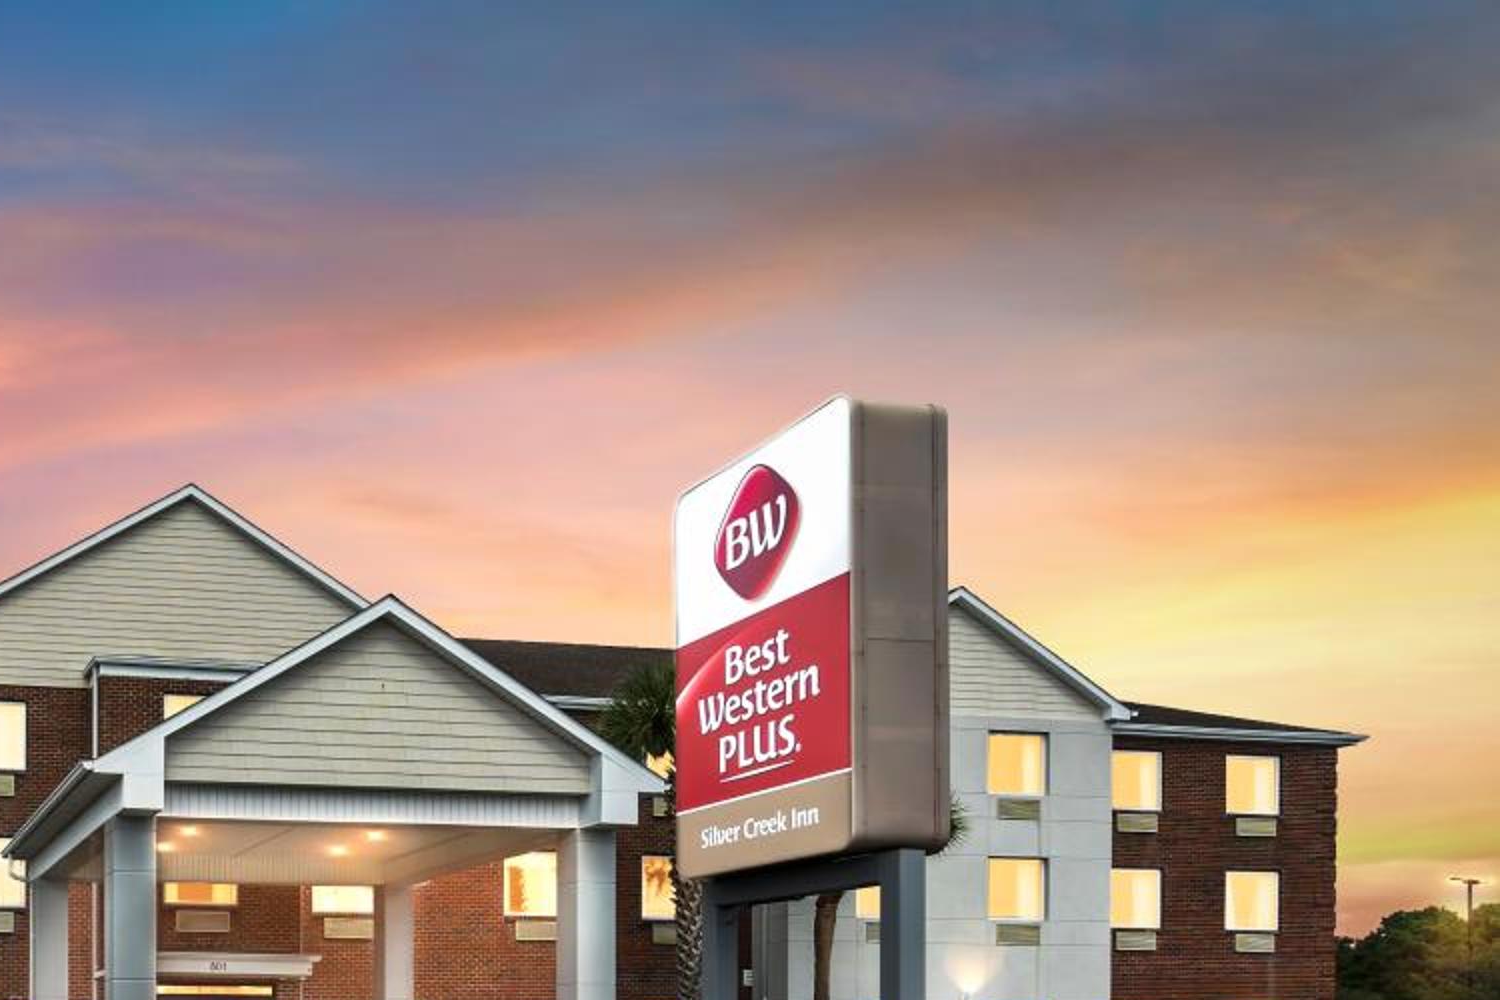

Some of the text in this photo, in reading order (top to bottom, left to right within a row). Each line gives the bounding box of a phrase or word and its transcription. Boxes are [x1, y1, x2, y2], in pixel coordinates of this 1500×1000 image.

[726, 494, 787, 571] BW
[725, 629, 791, 685] Best
[698, 665, 820, 735] Western
[701, 807, 819, 849] Silver Creek Inn
